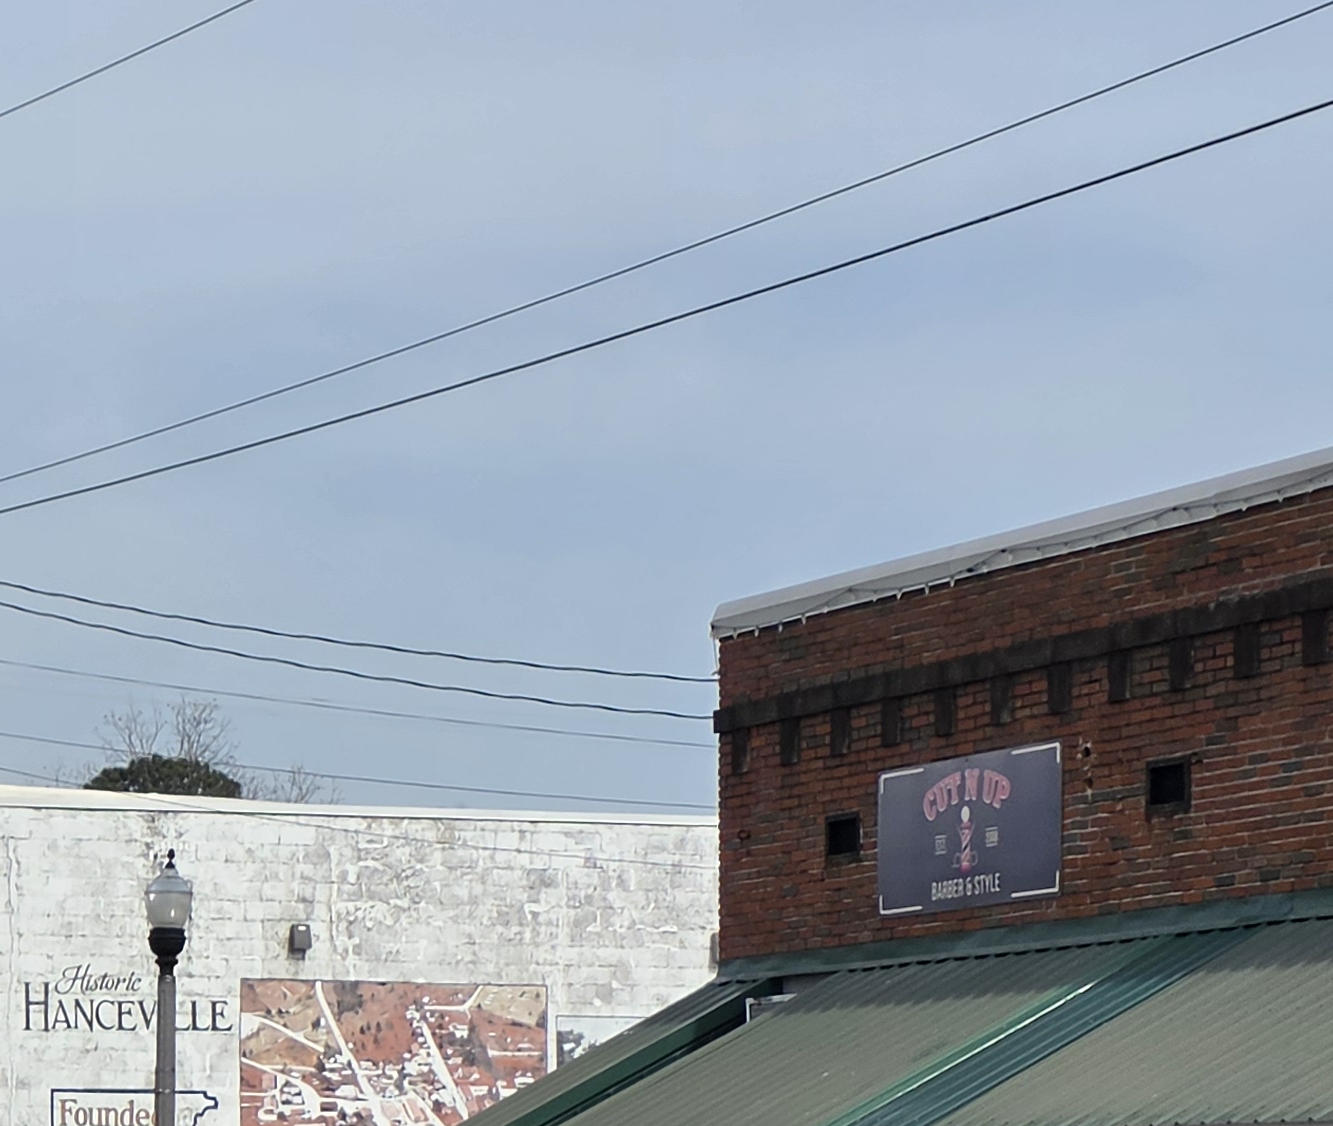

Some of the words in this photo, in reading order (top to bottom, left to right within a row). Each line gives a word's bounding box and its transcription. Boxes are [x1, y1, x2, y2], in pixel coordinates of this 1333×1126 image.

[923, 771, 962, 821] CUT
[964, 768, 980, 801] N
[982, 769, 1011, 809] UP
[932, 877, 964, 901] BARBER
[974, 873, 1001, 895] STYLE
[55, 963, 142, 995] Historic
[23, 981, 233, 1033] HANCEVLE
